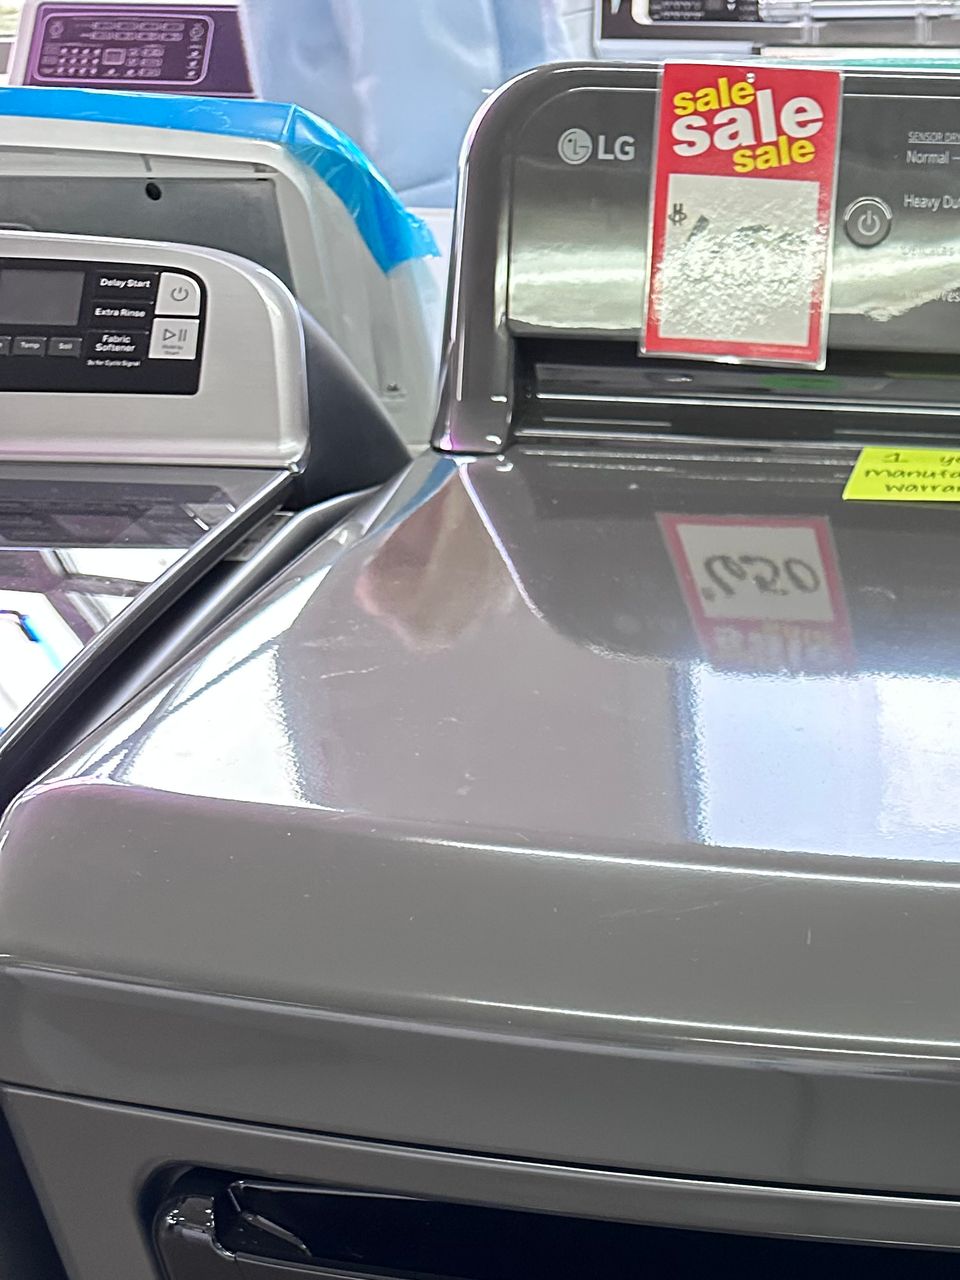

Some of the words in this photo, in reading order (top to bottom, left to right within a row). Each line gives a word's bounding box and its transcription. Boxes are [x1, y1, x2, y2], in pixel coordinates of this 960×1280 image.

[673, 77, 755, 116] sale
[671, 89, 824, 157] sale
[597, 135, 635, 160] LG
[732, 135, 816, 173] sale
[906, 150, 950, 165] Normal
[904, 194, 941, 212] Heavy
[100, 277, 126, 288] Delay
[127, 278, 151, 288] Start
[94, 307, 119, 317] Extra
[120, 308, 146, 318] Rinse
[102, 334, 131, 343] Fabric
[95, 343, 136, 353] Softener
[882, 453, 908, 463] 1
